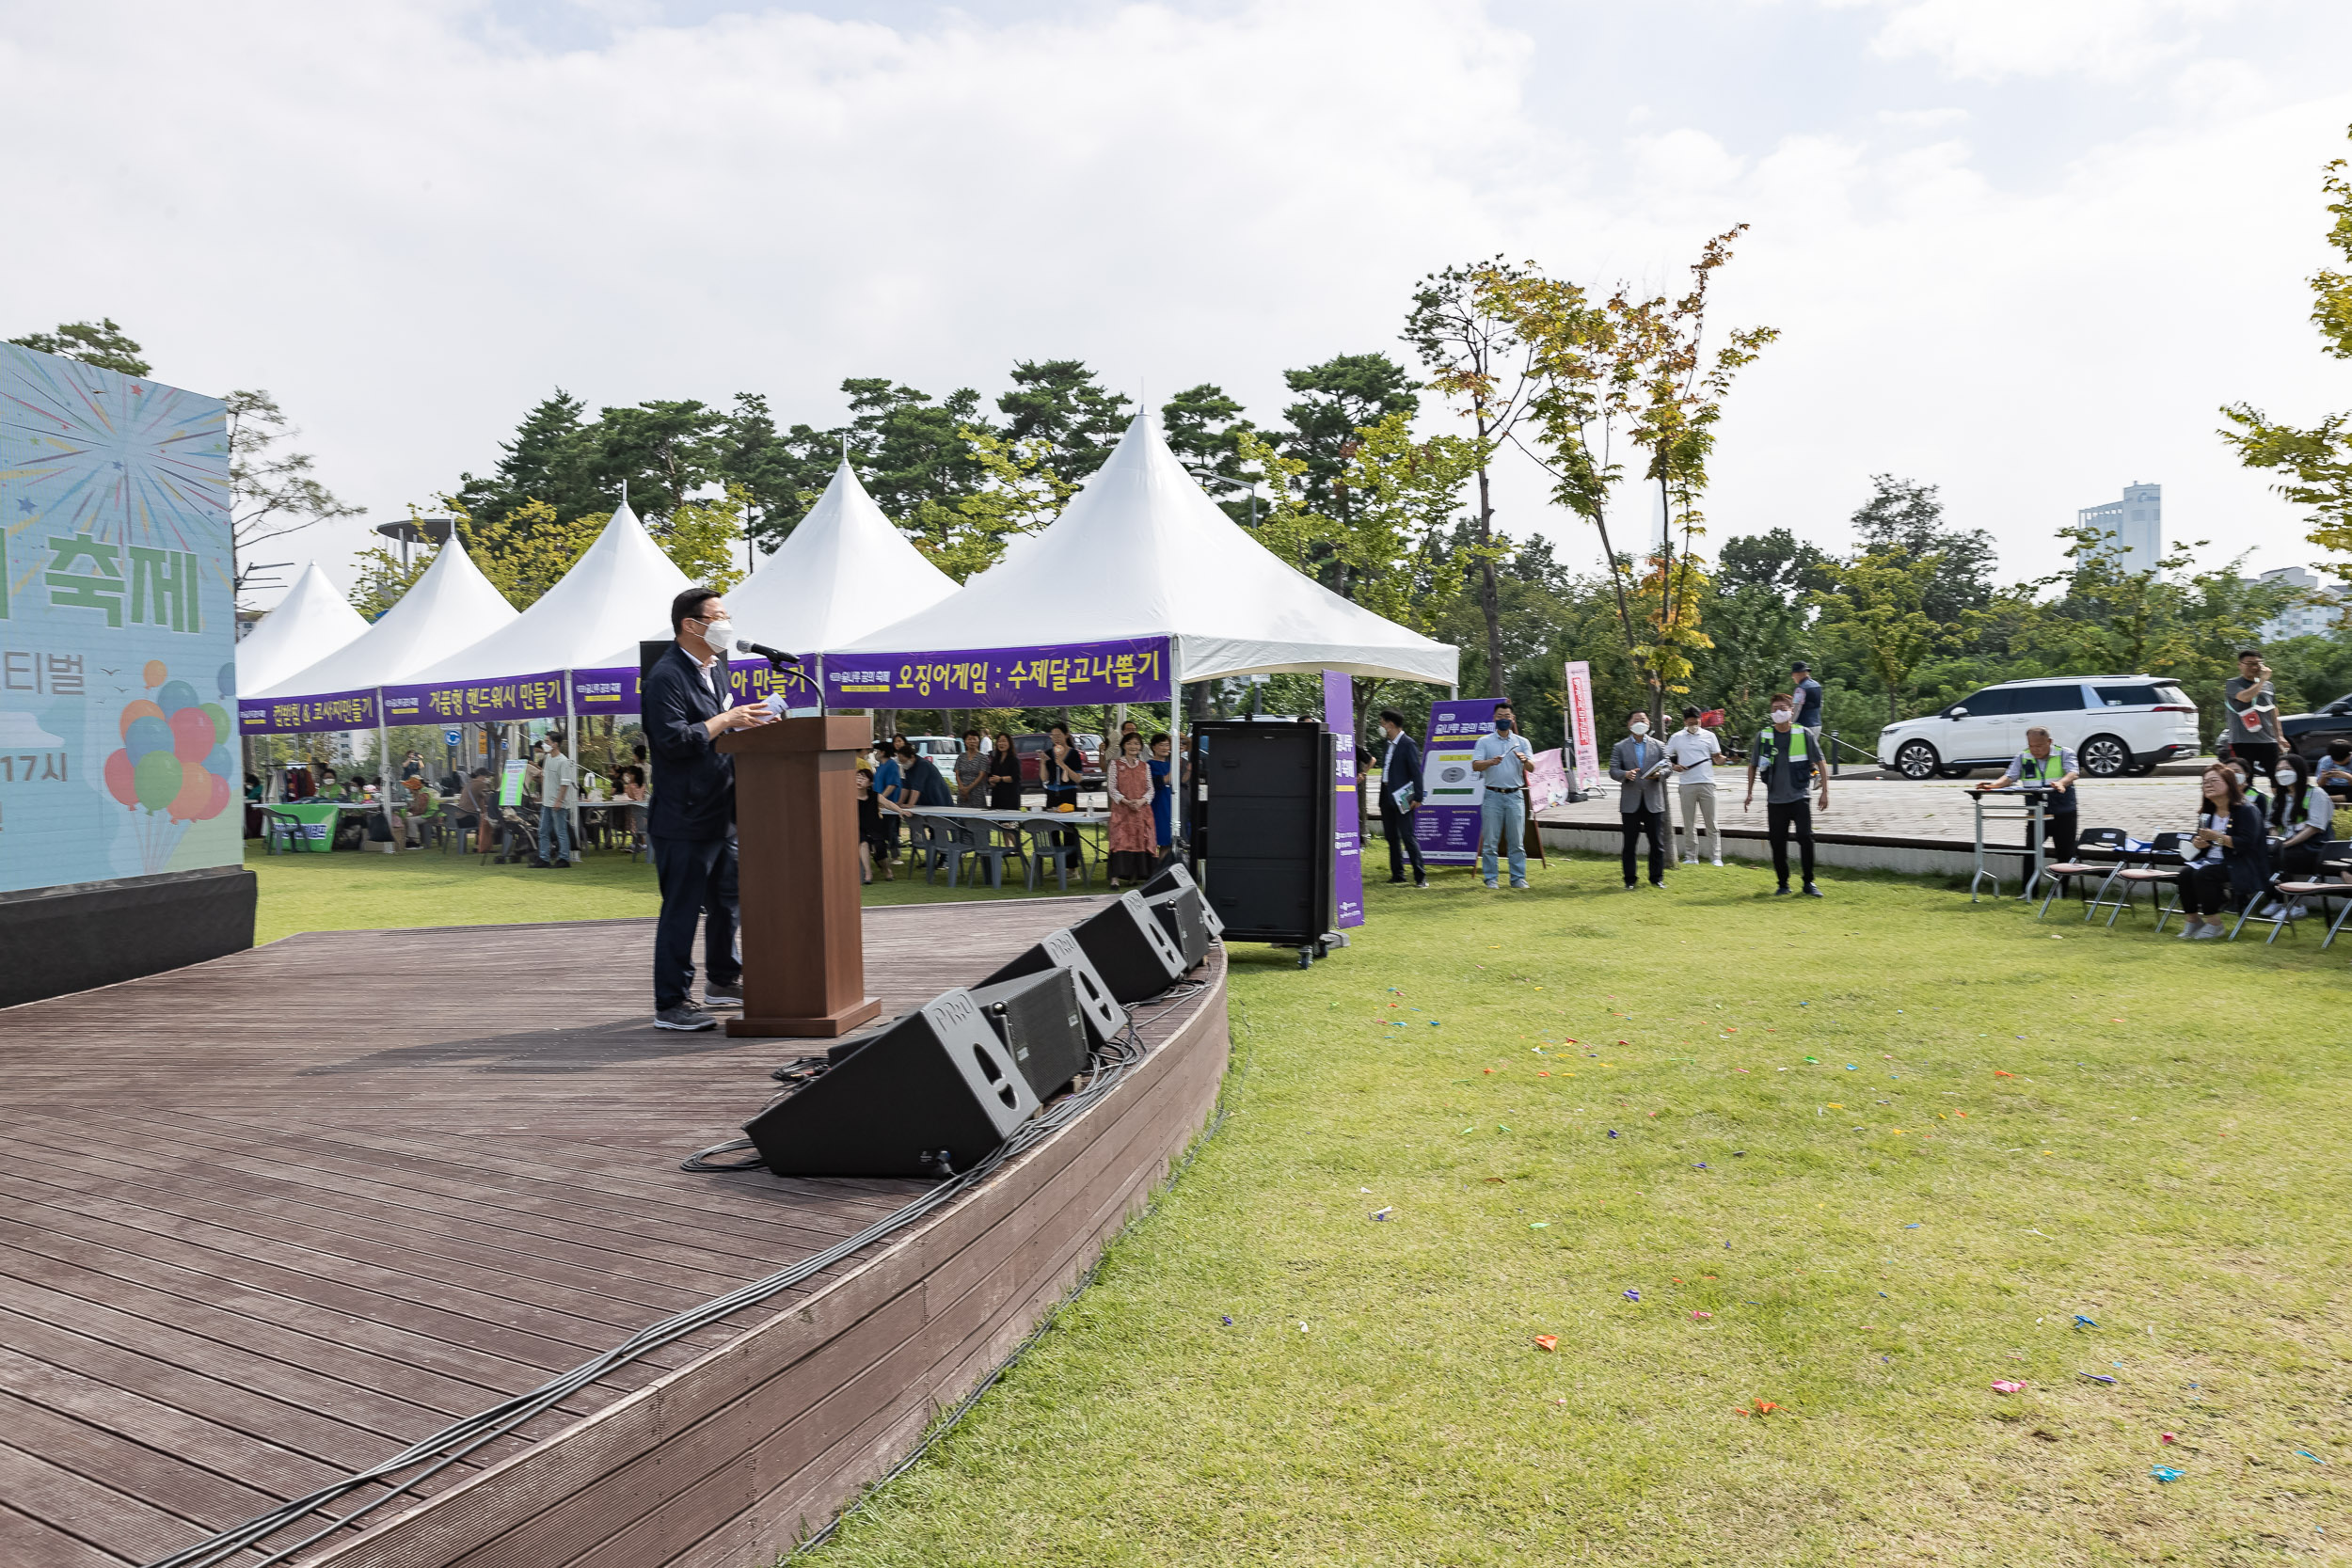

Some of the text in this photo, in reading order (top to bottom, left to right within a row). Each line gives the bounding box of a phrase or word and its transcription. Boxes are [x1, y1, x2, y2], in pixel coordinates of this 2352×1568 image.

[42, 531, 201, 636] 축제
[753, 664, 806, 701] 만들기
[896, 661, 989, 697] 오징어게임
[1008, 650, 1160, 692] 수제달고나뽑기
[428, 679, 563, 717] 거품형 핸드워시 만들기
[0, 752, 68, 783] 17시
